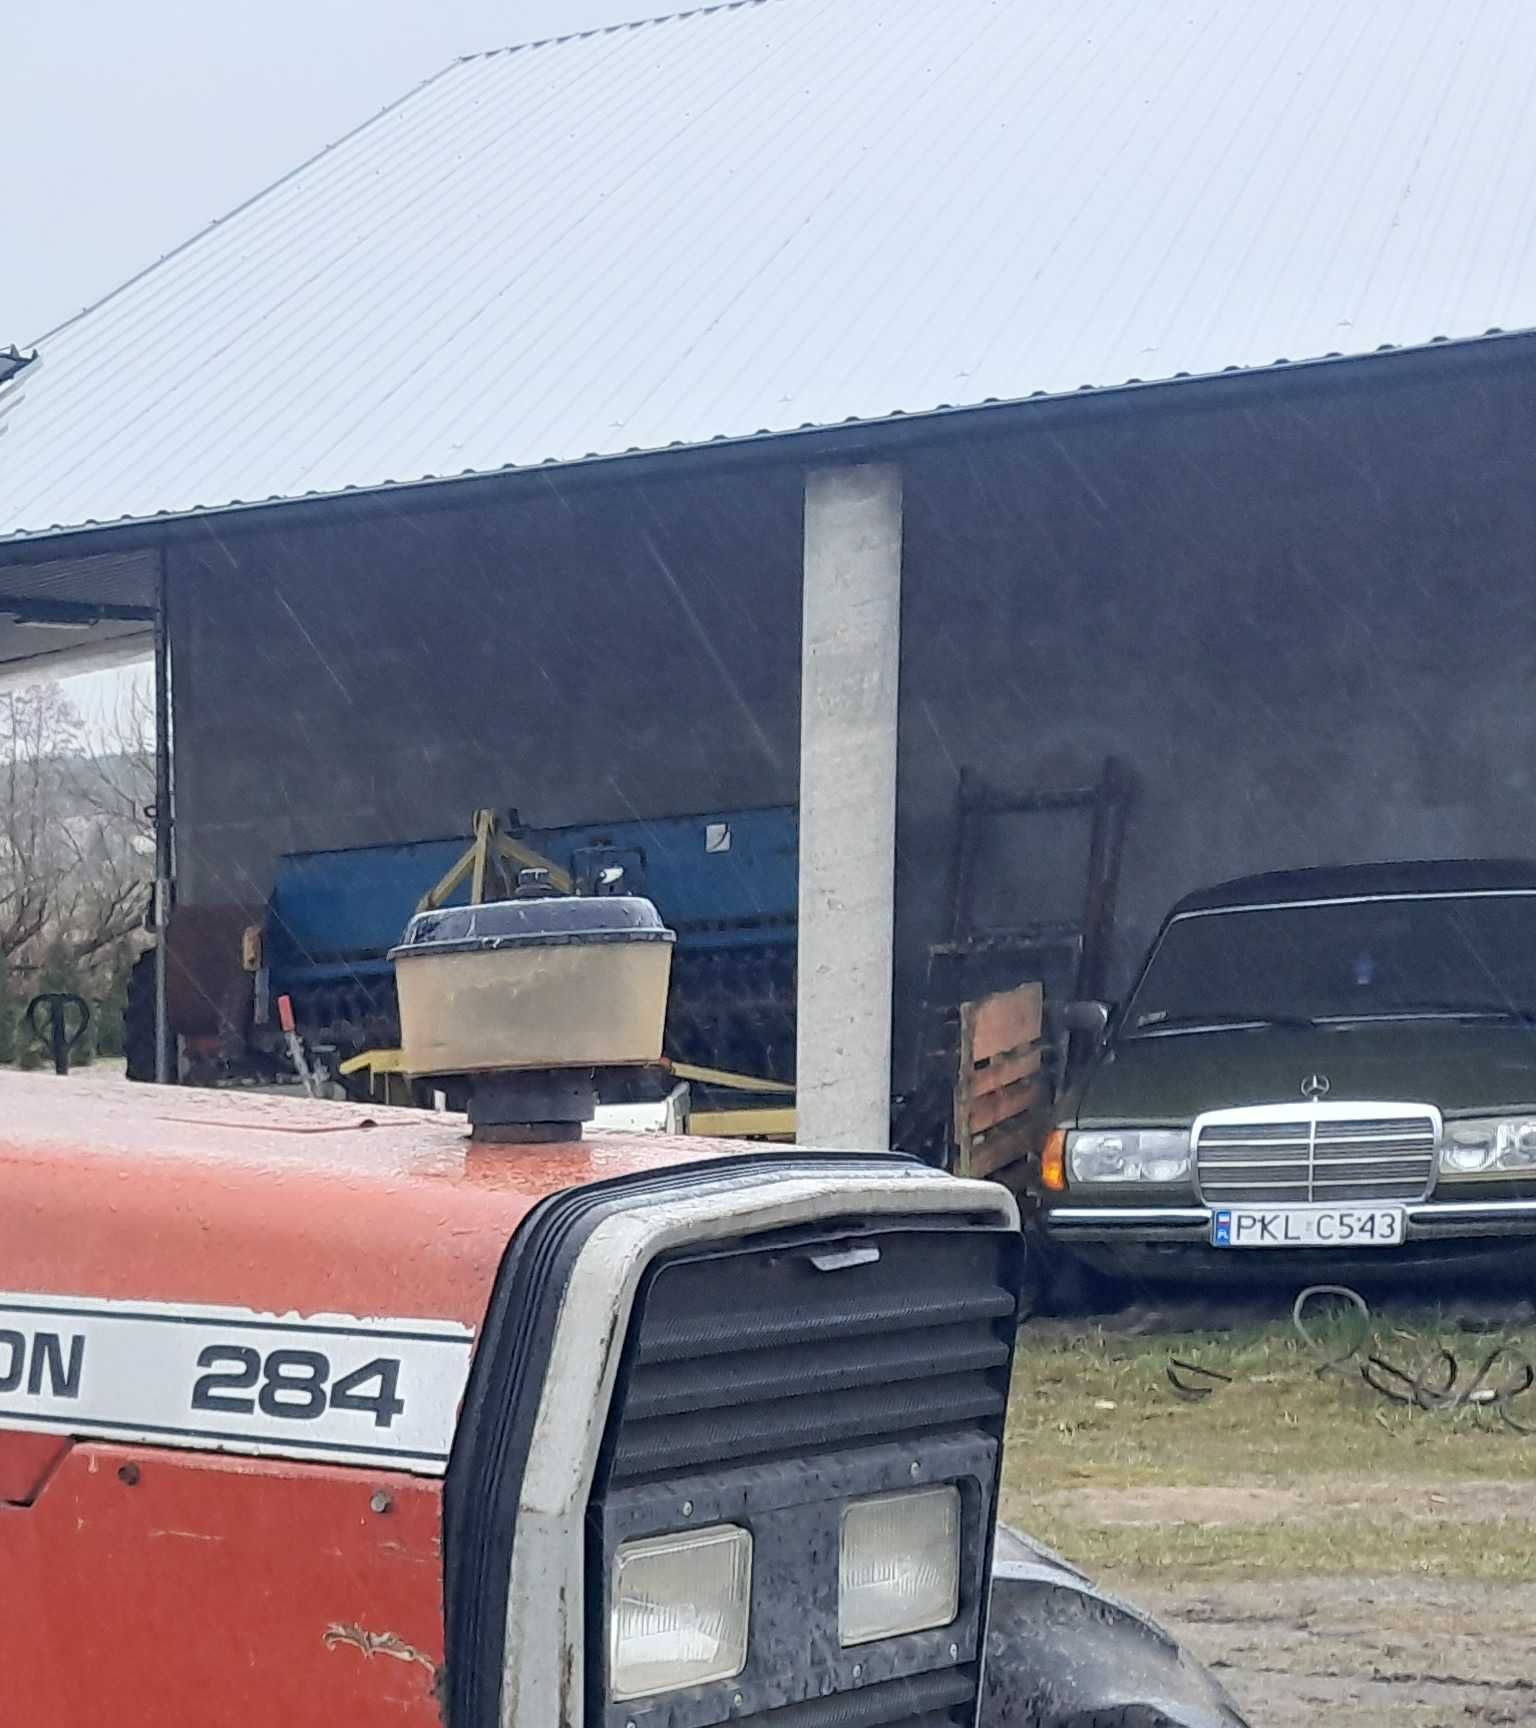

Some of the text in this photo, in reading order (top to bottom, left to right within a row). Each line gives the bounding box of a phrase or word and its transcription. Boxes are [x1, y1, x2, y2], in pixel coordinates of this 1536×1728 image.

[1236, 1213, 1396, 1241] PKL C543
[190, 1344, 405, 1428] 284
